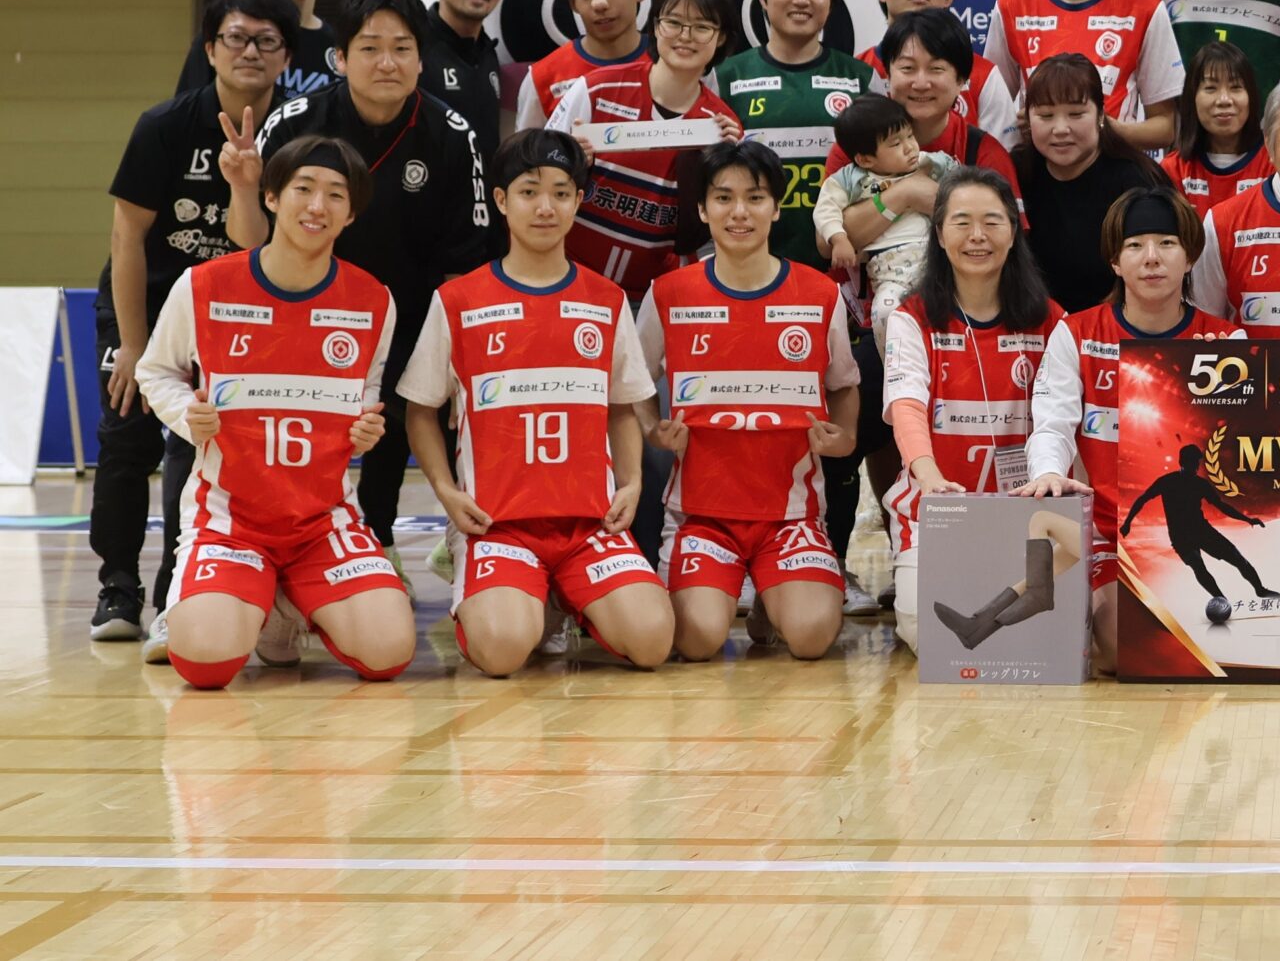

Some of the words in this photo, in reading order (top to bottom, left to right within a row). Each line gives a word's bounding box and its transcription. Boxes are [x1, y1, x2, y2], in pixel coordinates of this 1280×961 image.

[768, 138, 836, 148] 株式会社エフ・ビー
[780, 164, 826, 208] 23
[229, 334, 252, 356] LS
[487, 332, 506, 355] LS
[691, 334, 711, 355] LS
[710, 384, 817, 395] 株式会社エフ・ビー・エム
[1095, 370, 1116, 390] LS
[258, 416, 312, 467] 16
[519, 411, 569, 465] 19
[926, 504, 967, 512] Panasonic
[980, 667, 1041, 680] レッグリフレ
